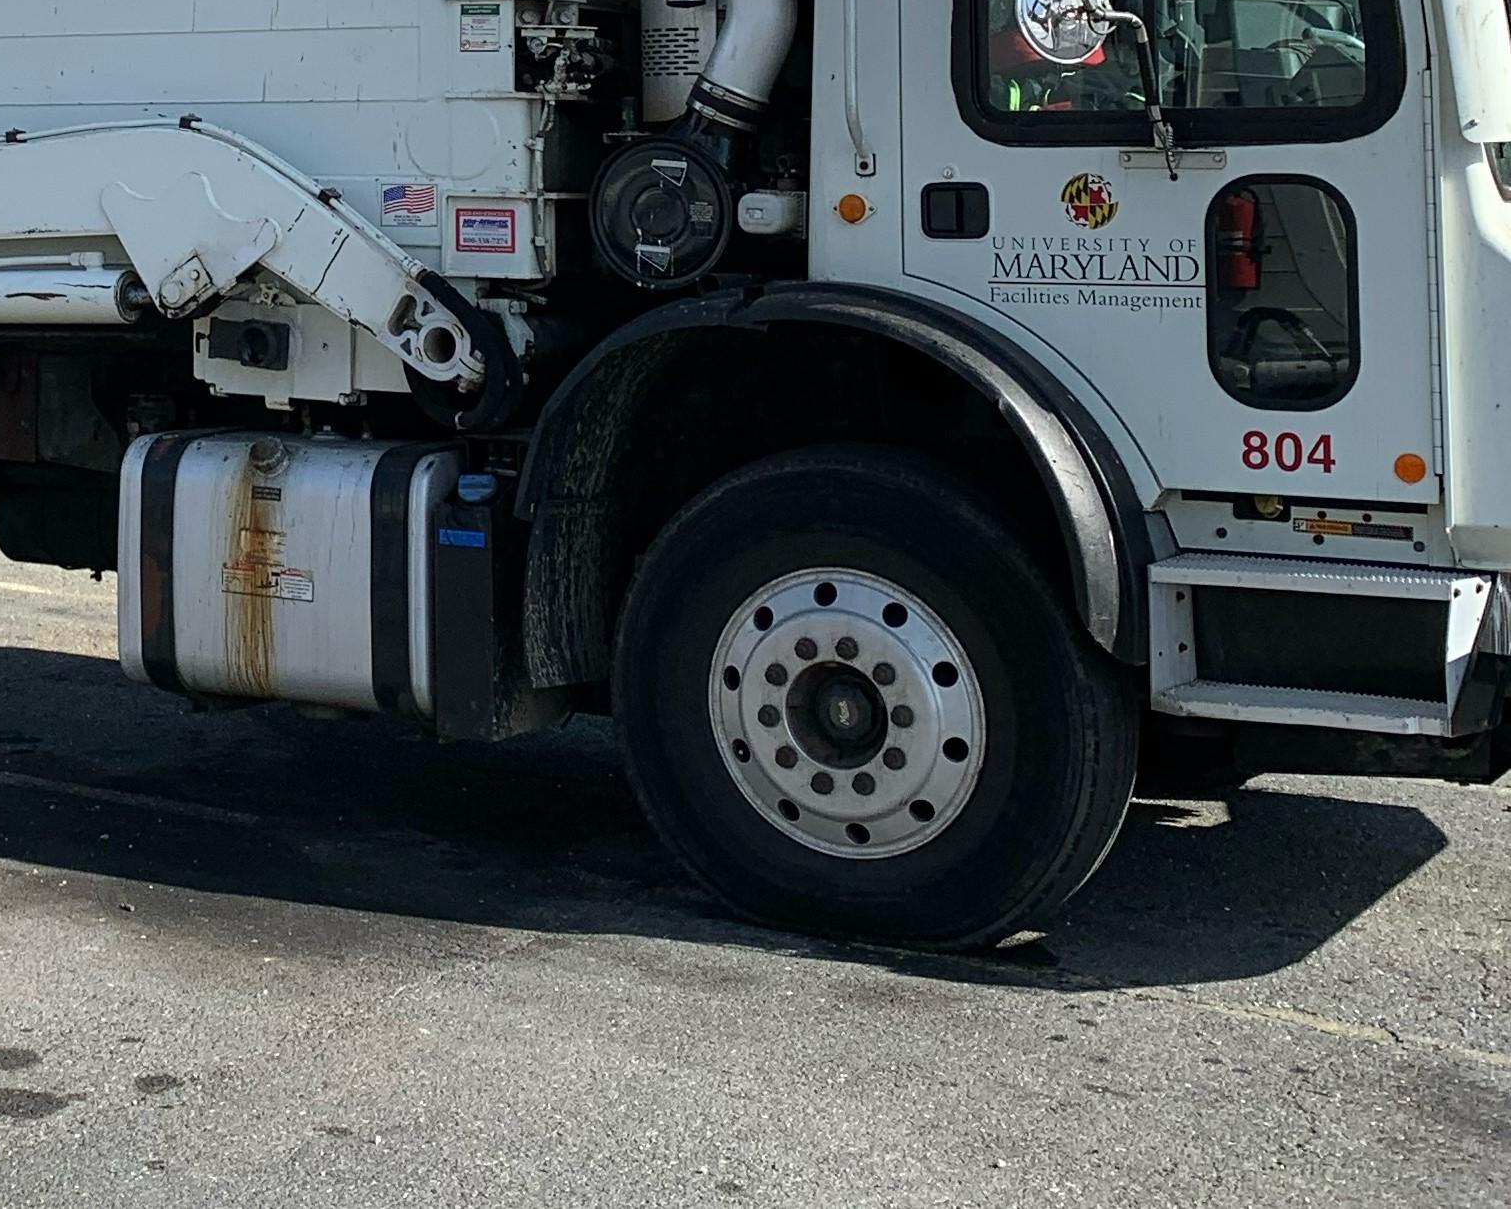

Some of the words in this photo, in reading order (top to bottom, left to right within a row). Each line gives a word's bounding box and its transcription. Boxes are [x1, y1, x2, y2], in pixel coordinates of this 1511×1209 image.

[991, 236, 1150, 252] UNIVERSITY
[1169, 238, 1198, 253] OF
[991, 252, 1200, 282] MARYLAND
[990, 286, 1070, 305] Facilities
[1077, 288, 1203, 312] Management
[1241, 430, 1337, 474] 804
